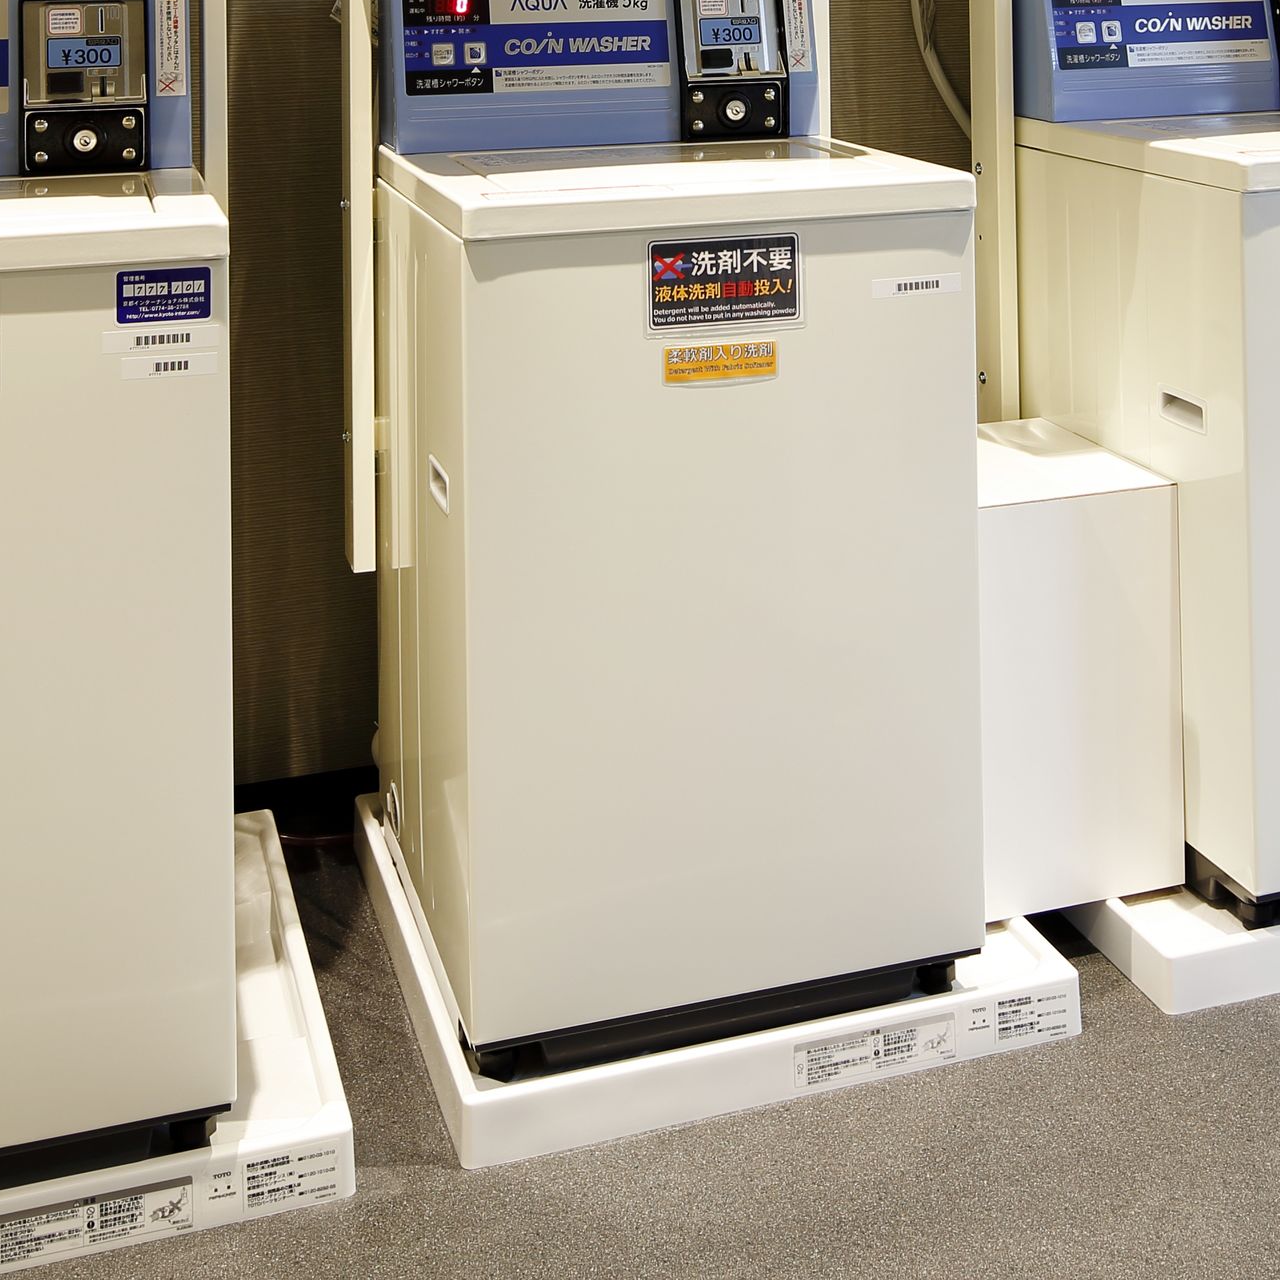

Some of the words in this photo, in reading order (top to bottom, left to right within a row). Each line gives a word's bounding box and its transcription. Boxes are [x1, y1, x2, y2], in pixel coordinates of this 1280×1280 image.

[1186, 15, 1252, 31] WASHER
[712, 28, 753, 42] ¥300
[569, 36, 651, 53] WASHER
[61, 48, 112, 65] ¥300
[416, 78, 483, 89] 洗濯槽シャワーボタン
[690, 246, 793, 276] 洗剤不要
[654, 278, 793, 303] 液体洗剤自動投入!
[654, 308, 686, 316] Detergent
[711, 304, 730, 312] added
[732, 301, 776, 310] automatically.
[772, 307, 797, 315] powder.
[668, 342, 773, 364] 柔軟剤入り洗剤
[213, 1171, 231, 1179] TOTO
